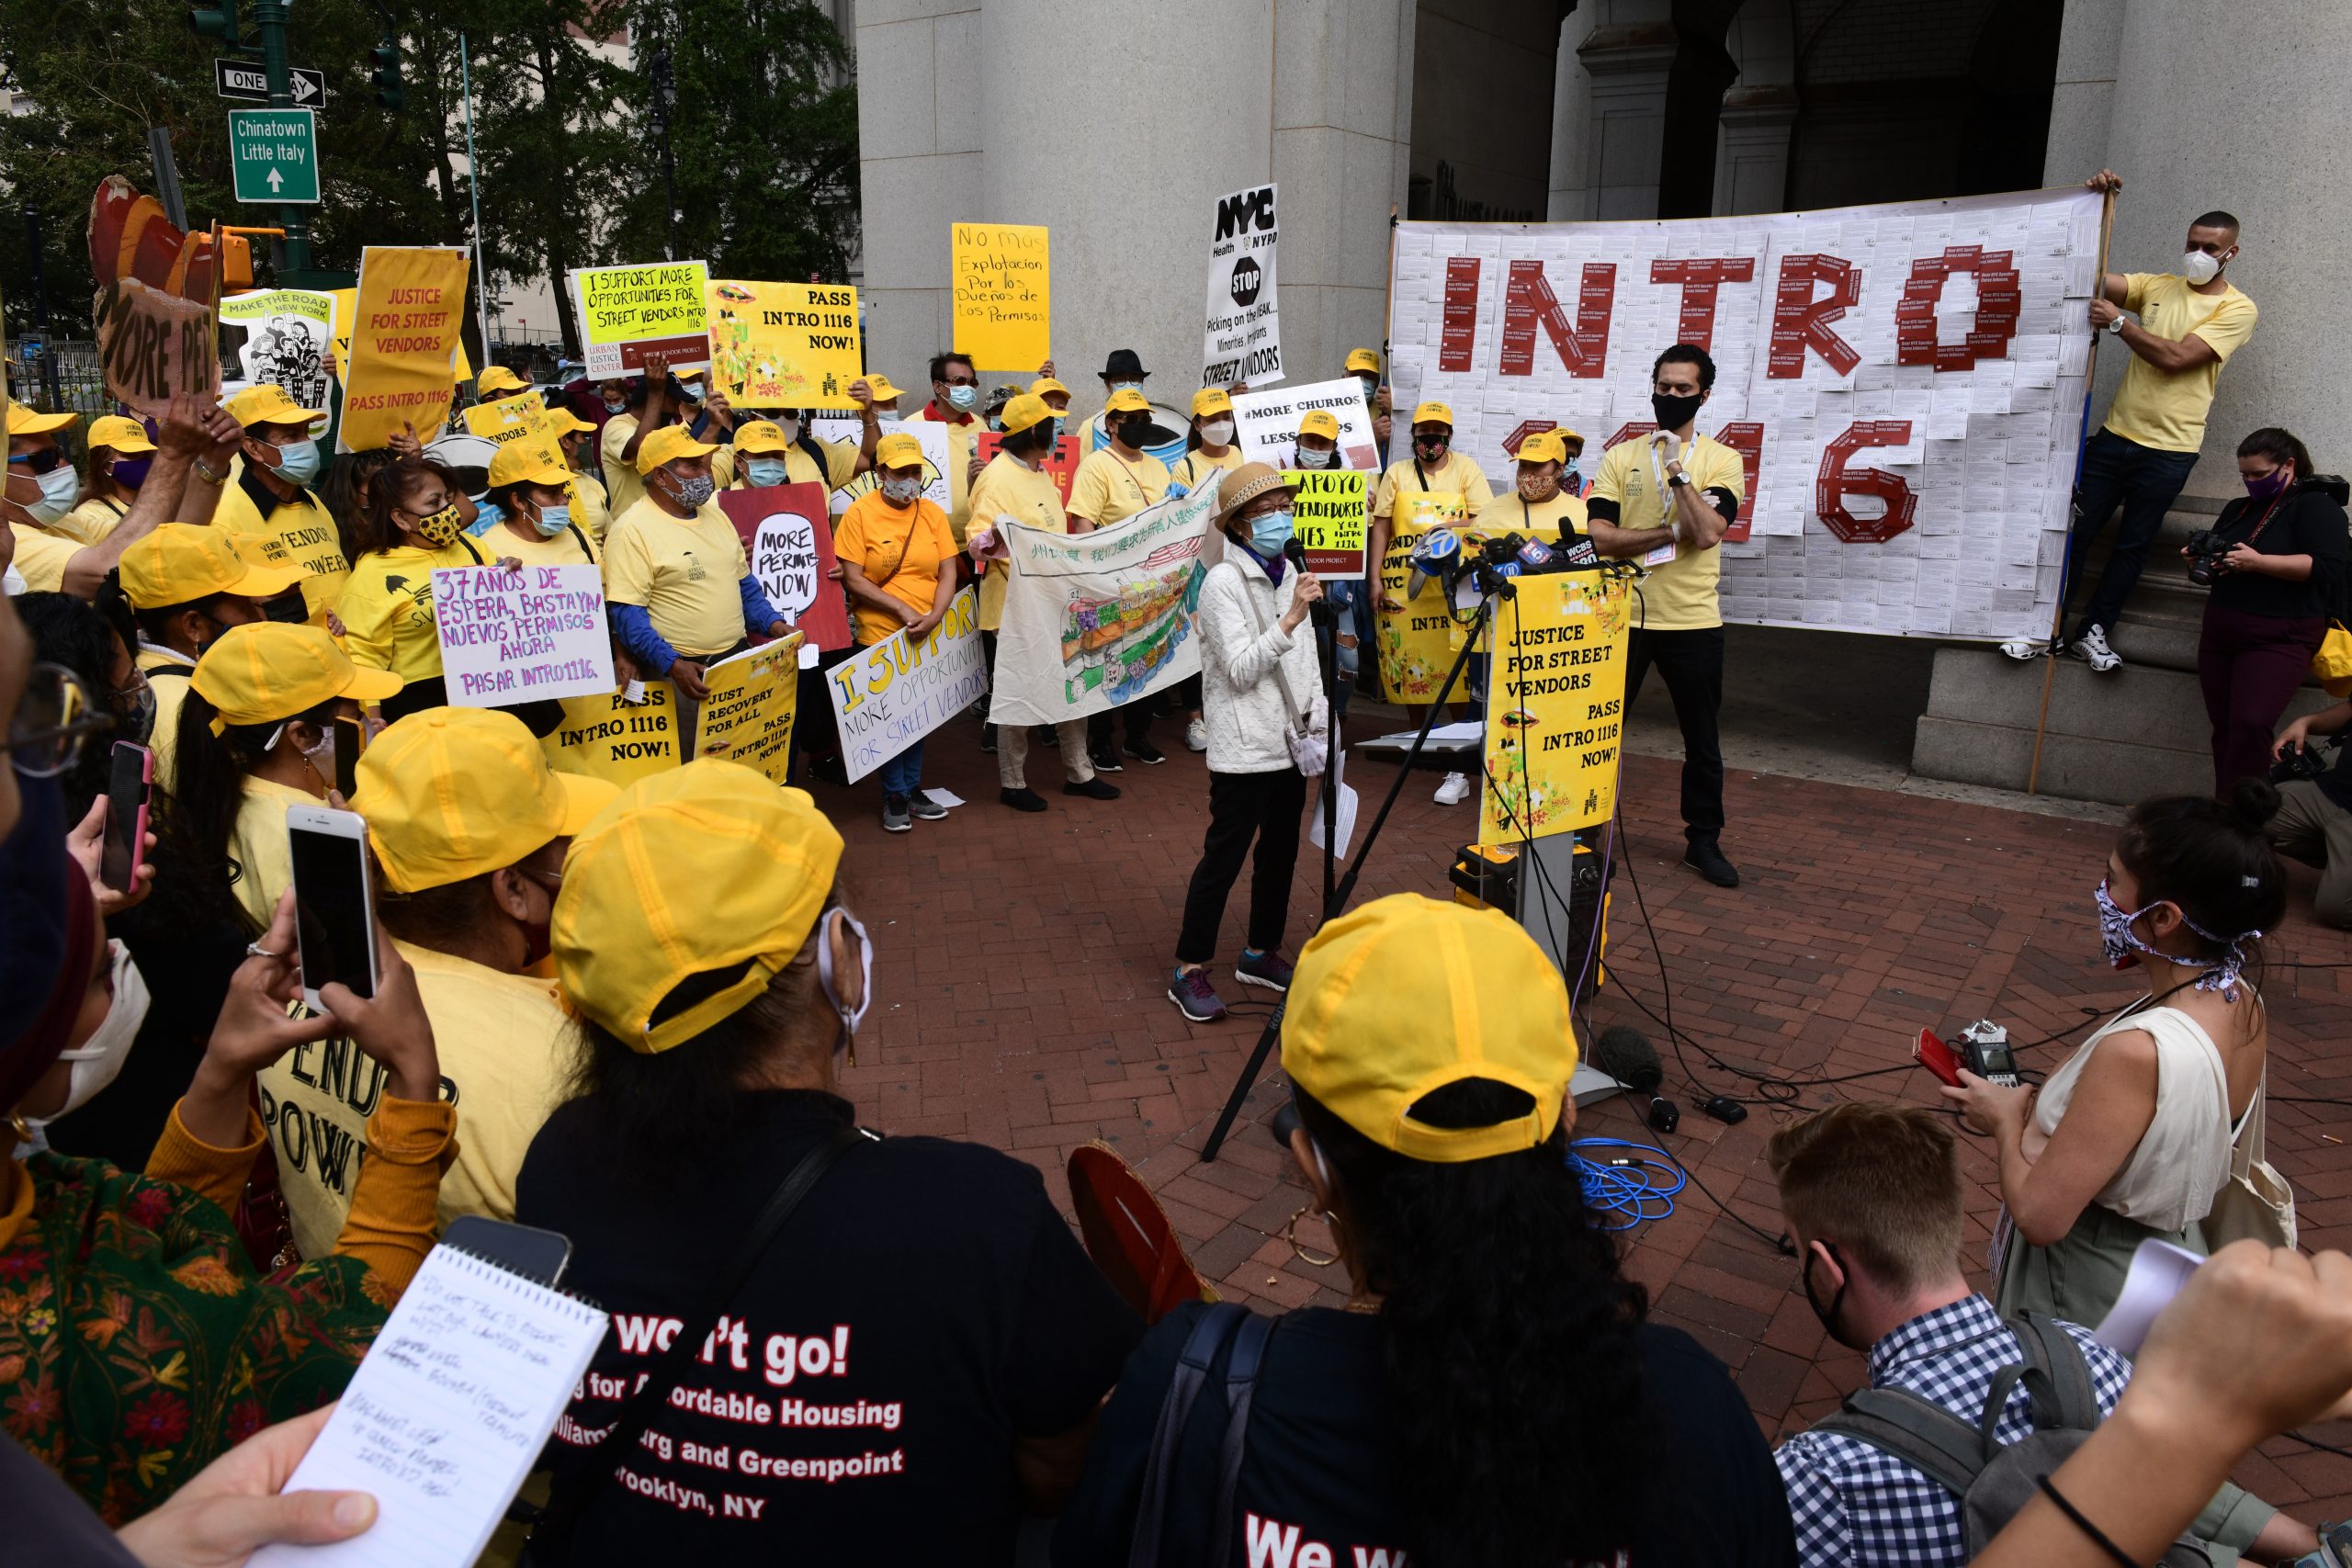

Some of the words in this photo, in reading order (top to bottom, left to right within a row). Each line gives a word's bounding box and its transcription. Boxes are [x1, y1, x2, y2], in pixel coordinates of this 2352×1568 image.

[233, 73, 265, 89] ONE
[291, 78, 308, 95] AY
[237, 119, 306, 137] Chinatown
[241, 143, 273, 161] Little
[277, 144, 305, 164] Italy
[1215, 188, 1275, 243] NYC
[1213, 243, 1235, 258] Health
[1251, 231, 1278, 249] NYPD
[959, 254, 1043, 274] Explotacion
[589, 274, 602, 292] I
[600, 268, 656, 289] SUPPORT
[660, 267, 694, 286] MORE
[965, 275, 993, 290] Por
[1003, 271, 1025, 289] los
[1232, 271, 1261, 294] STOP
[229, 299, 265, 313] MAKE
[265, 294, 290, 305] THE
[292, 293, 329, 310] ROAD
[387, 288, 441, 304] JUSTICE
[588, 288, 672, 309] OPPORTUNITIES
[675, 287, 698, 302] FOR
[808, 290, 851, 307] PASS
[956, 288, 1013, 302] Dueños
[1019, 288, 1037, 302] de
[275, 303, 298, 313] NEW
[302, 304, 326, 319] YORK
[370, 313, 401, 329] FOR
[402, 311, 448, 329] STREET
[596, 308, 637, 328] STREET
[640, 306, 684, 323] VENDORS
[686, 307, 707, 318] INTRO
[763, 310, 820, 327] INTRO
[823, 313, 853, 329] 1116
[987, 305, 1046, 322] Permisos
[1206, 316, 1232, 334] Picking
[1234, 315, 1245, 327] on
[1246, 309, 1257, 323] the
[687, 318, 701, 329] 1116
[96, 276, 172, 398] MORE
[376, 335, 441, 354] VENDORS
[808, 334, 854, 350] NOW!
[589, 344, 618, 355] URBAN
[681, 346, 701, 355] PROJECT
[590, 354, 620, 364] JUSTICE
[591, 362, 623, 373] CENTER
[1202, 359, 1240, 389] STREET
[349, 395, 385, 412] PASS
[387, 392, 425, 408] INTRO
[427, 389, 449, 404] 1116
[1244, 404, 1293, 421] #MORE
[1296, 395, 1361, 412] CHURROS
[488, 426, 527, 444] ENDORS
[1260, 431, 1296, 446] LESS
[1297, 473, 1363, 497] APOYO
[761, 526, 811, 553] MORE
[1334, 530, 1363, 538] INTRO
[1414, 544, 1431, 558] abc
[1424, 529, 1458, 559] 7
[1523, 540, 1537, 554] FOX
[1532, 547, 1543, 560] 5
[1566, 539, 1592, 558] WCBS
[759, 553, 820, 575] PERMITS
[435, 570, 469, 601] 37
[474, 567, 526, 596] AÑOS
[536, 567, 562, 590] DE
[763, 573, 811, 599] NOW
[436, 595, 516, 627] ESPERA,
[441, 621, 508, 648] NUEVOS
[514, 613, 594, 640] PERMISOS
[1509, 624, 1585, 648] JUSTICE
[500, 636, 556, 661] AHORA
[1507, 654, 1545, 673] FOR
[1548, 645, 1612, 670] STREET
[459, 670, 517, 696] PASAR
[832, 663, 865, 716] I
[1505, 672, 1591, 698] VENDORS
[707, 687, 775, 722] RECOVERY
[708, 686, 745, 705] JUST
[844, 692, 893, 743] MORE
[1587, 699, 1621, 720] PASS
[560, 719, 625, 748] INTRO
[629, 716, 668, 734] 1116
[706, 719, 733, 737] FOR
[735, 708, 762, 727] ALL
[763, 712, 792, 733] PASS
[851, 739, 882, 776] FOR
[887, 696, 931, 749] STREET
[935, 667, 989, 717] VENDORS
[730, 736, 769, 761] INTRO
[770, 727, 789, 744] 1116
[1543, 728, 1594, 751] INTRO
[1597, 722, 1618, 742] 1116
[610, 741, 671, 761] NOW!
[758, 740, 786, 762] NOW!
[1580, 746, 1617, 769] NOW!
[763, 1325, 851, 1386] go!
[589, 1372, 626, 1400] for
[779, 1398, 902, 1431] Housing
[681, 1440, 729, 1470] and
[738, 1449, 904, 1483] Greenpoint
[615, 1465, 715, 1517] rooklyn,
[723, 1494, 765, 1519] NY
[1244, 1509, 1336, 1568] We
